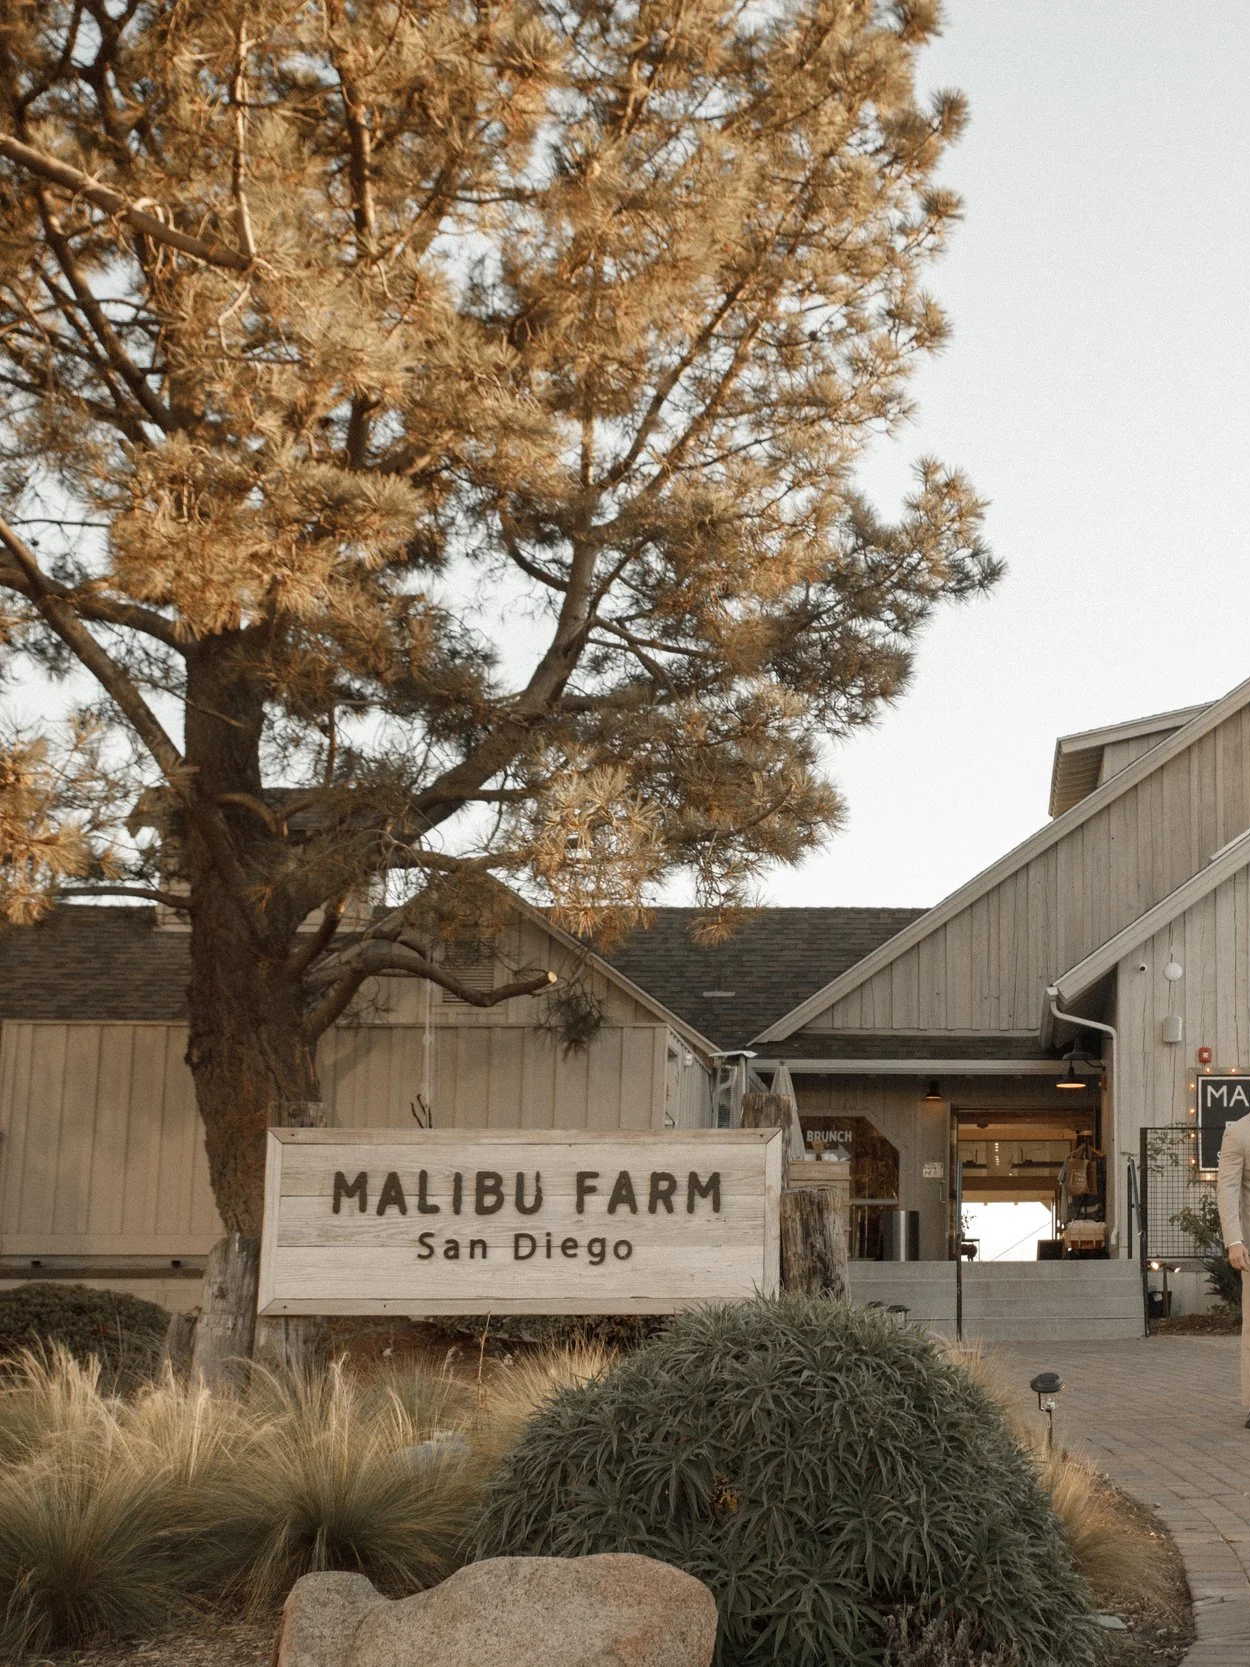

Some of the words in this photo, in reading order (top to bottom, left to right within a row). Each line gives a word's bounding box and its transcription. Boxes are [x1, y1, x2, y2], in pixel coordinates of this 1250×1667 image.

[806, 1130, 852, 1142] BRUNCH
[332, 1169, 544, 1217] MALIBU
[575, 1170, 722, 1216] FARM
[416, 1231, 488, 1261] San
[513, 1232, 634, 1266] Diego
